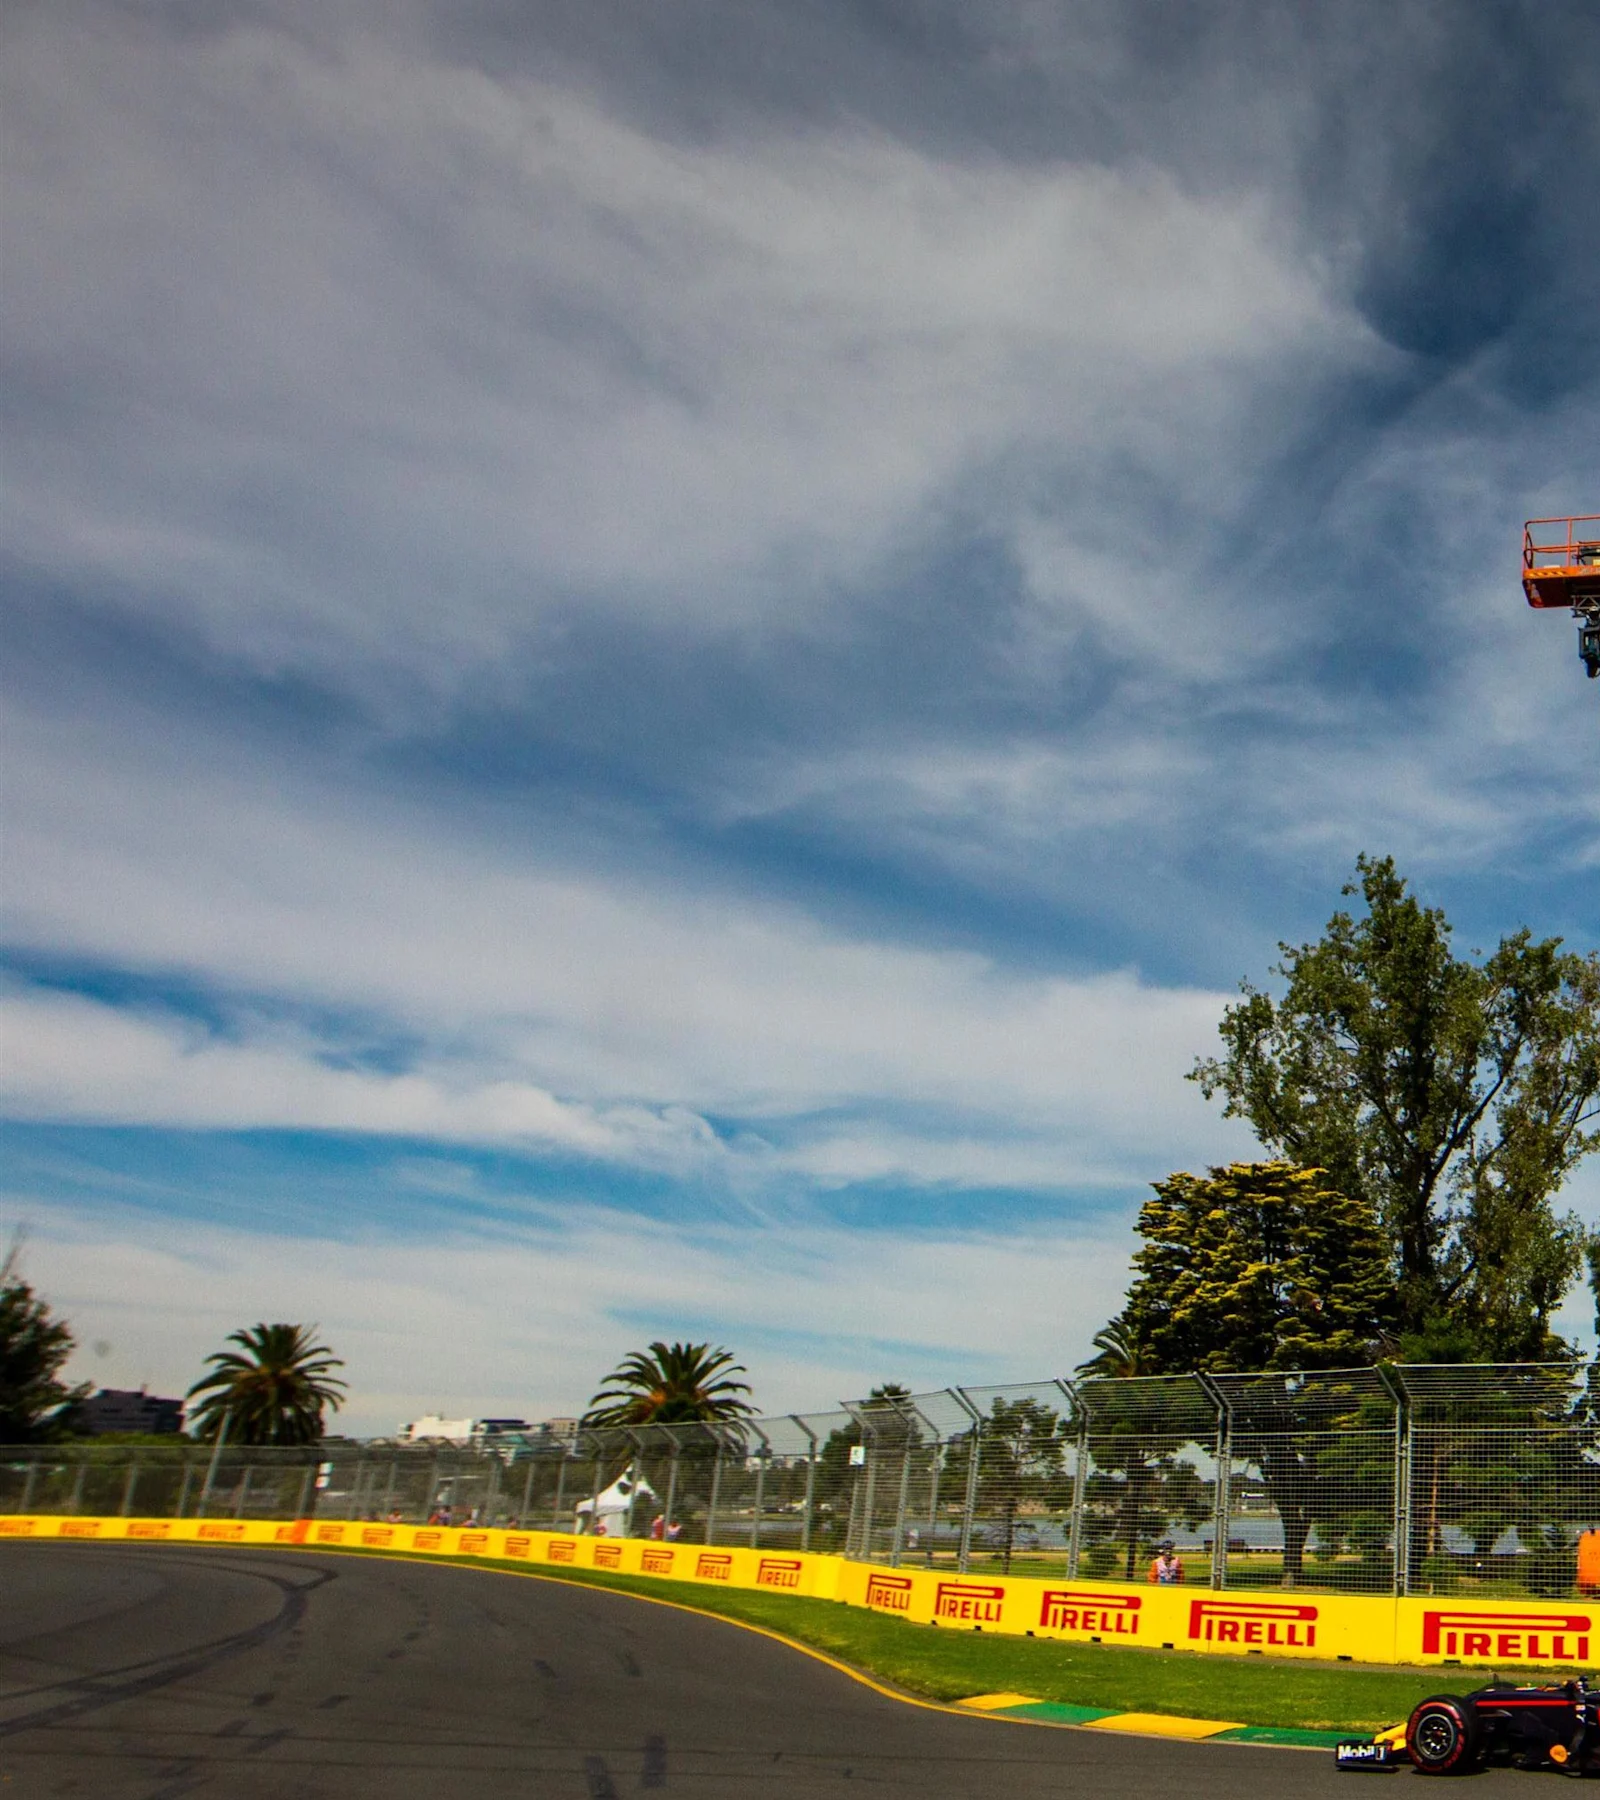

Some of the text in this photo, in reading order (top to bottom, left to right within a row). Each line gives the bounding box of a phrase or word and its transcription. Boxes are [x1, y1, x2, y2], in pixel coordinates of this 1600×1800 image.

[756, 1558, 802, 1588] PIRELLI
[866, 1574, 912, 1611] PIRELLI
[935, 1583, 1005, 1622] PIRELLI
[1039, 1591, 1142, 1634] PIRELLI
[1188, 1600, 1318, 1647] PIRELLI
[1422, 1611, 1591, 1660] PIRELLI
[1338, 1745, 1375, 1760] Mobil
